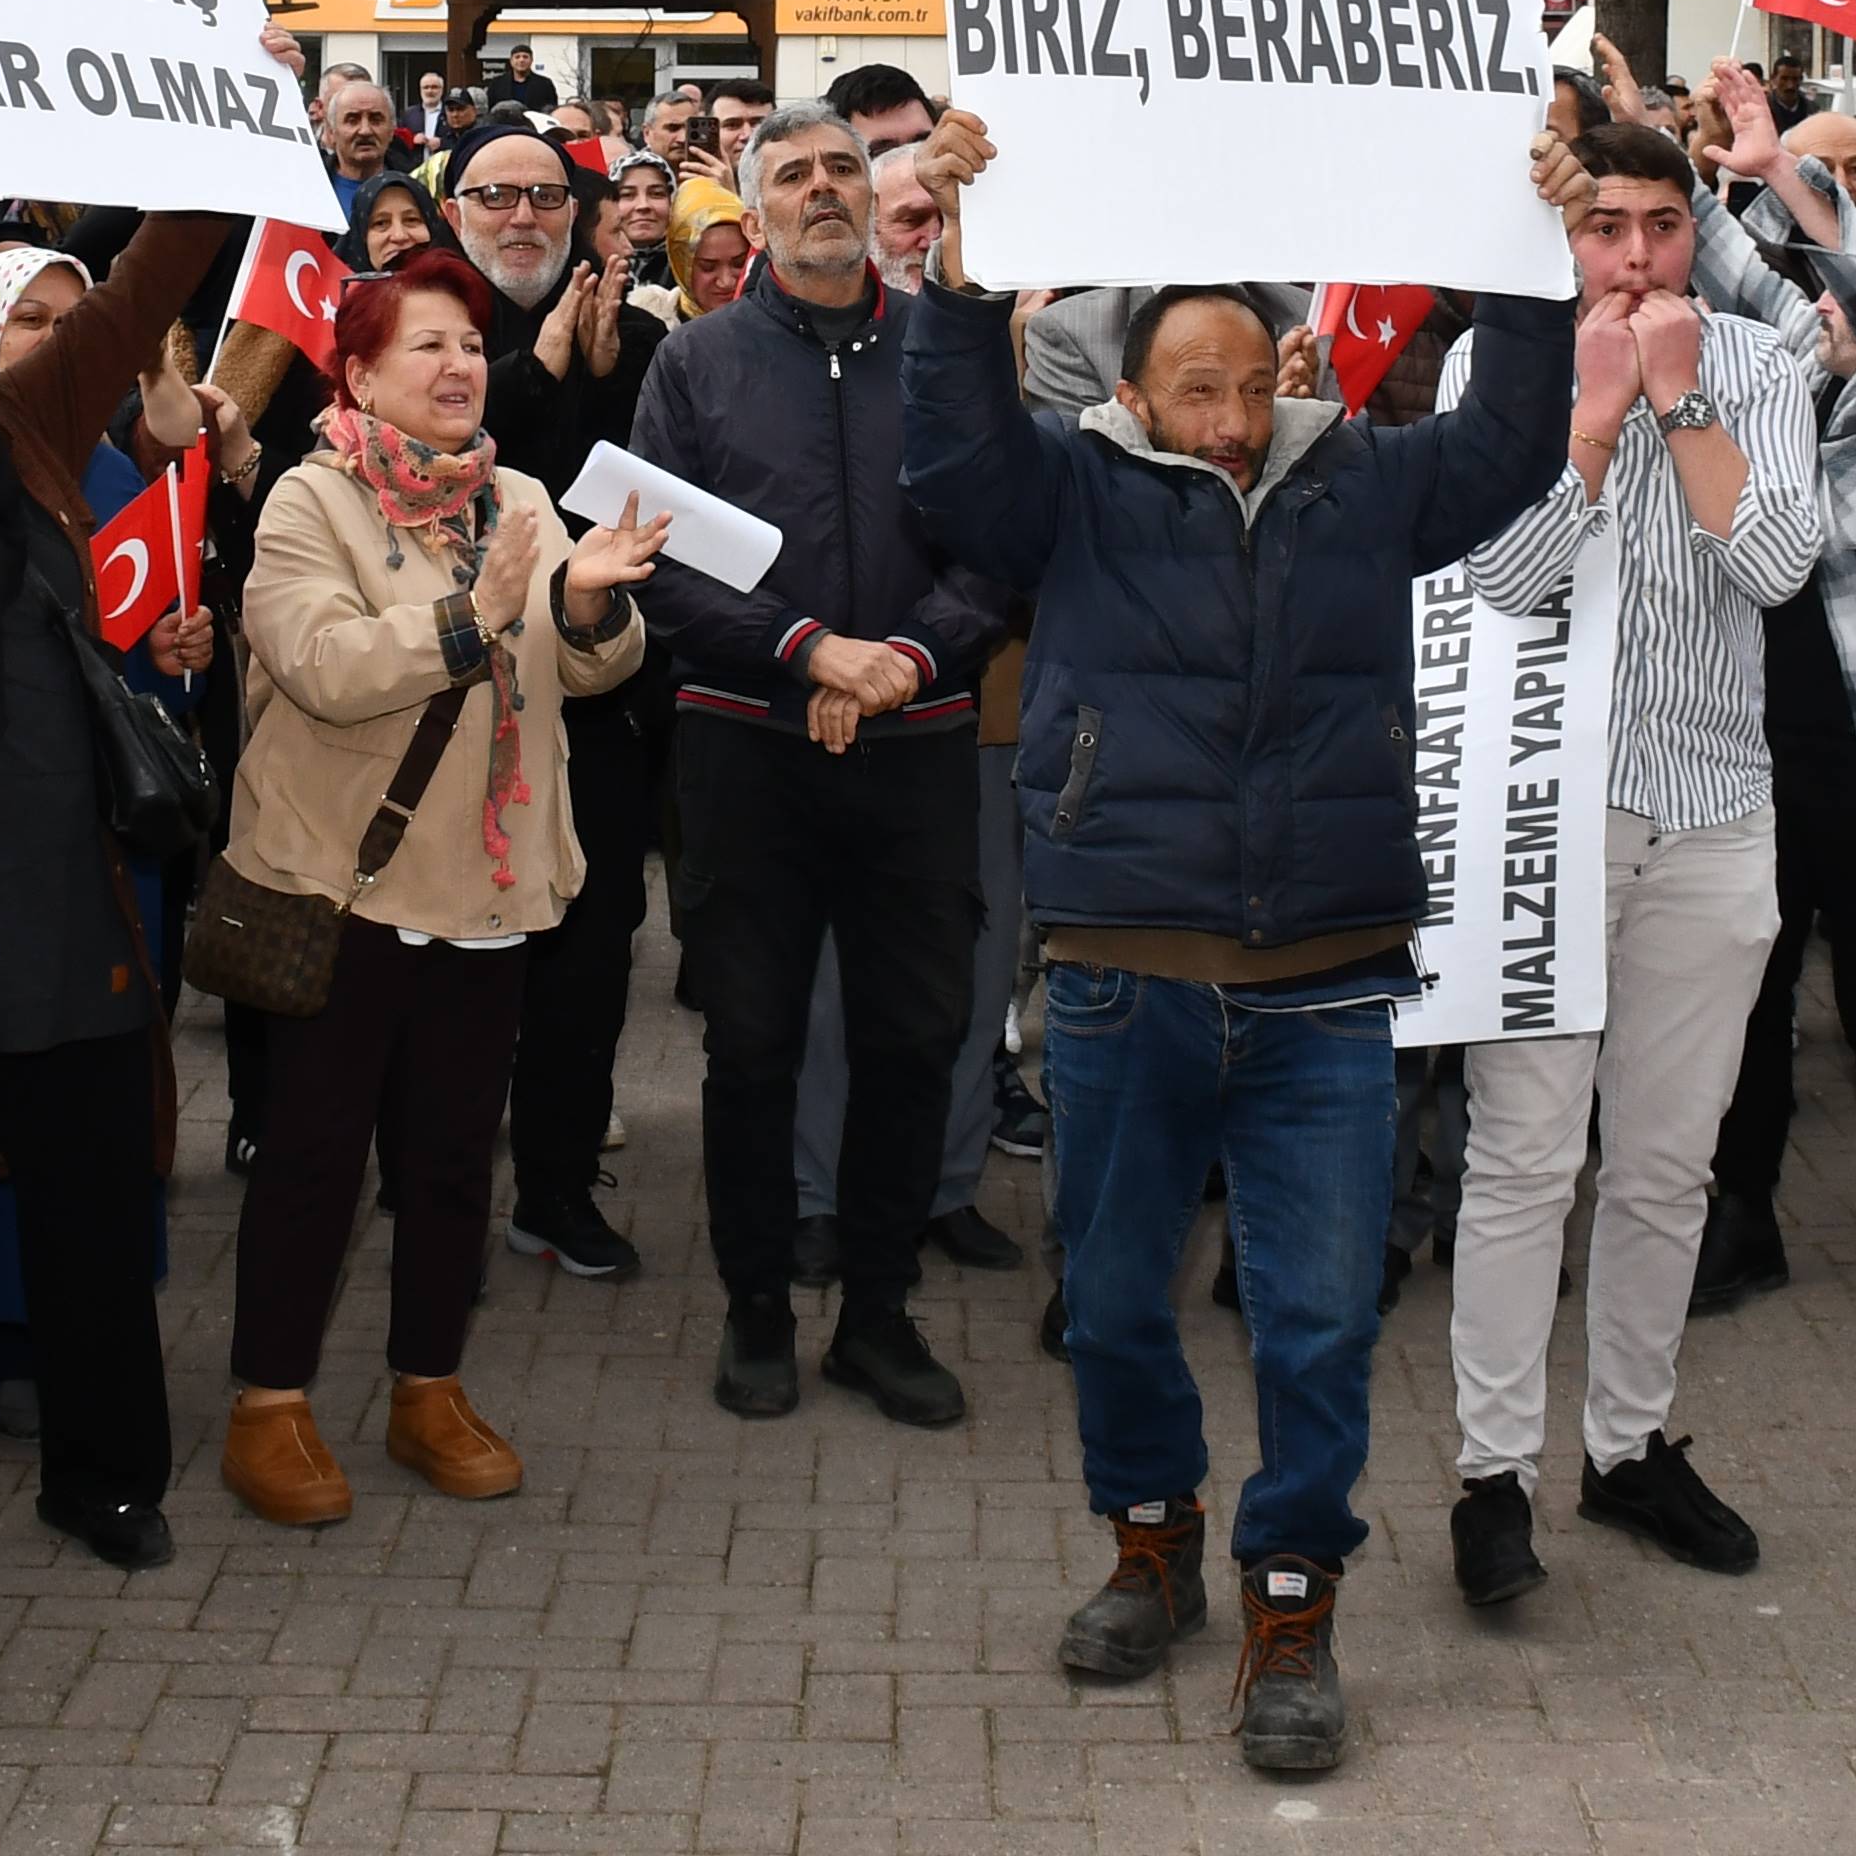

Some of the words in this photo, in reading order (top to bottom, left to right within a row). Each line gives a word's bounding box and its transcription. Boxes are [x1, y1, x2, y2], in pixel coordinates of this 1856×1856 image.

[66, 46, 313, 147] OLMAZ.
[795, 5, 929, 23] vakifbank.com.tr
[1417, 576, 1477, 926] MENFAATLERE
[1509, 566, 1576, 768] YAPILA
[1502, 777, 1561, 1032] MALZEME
